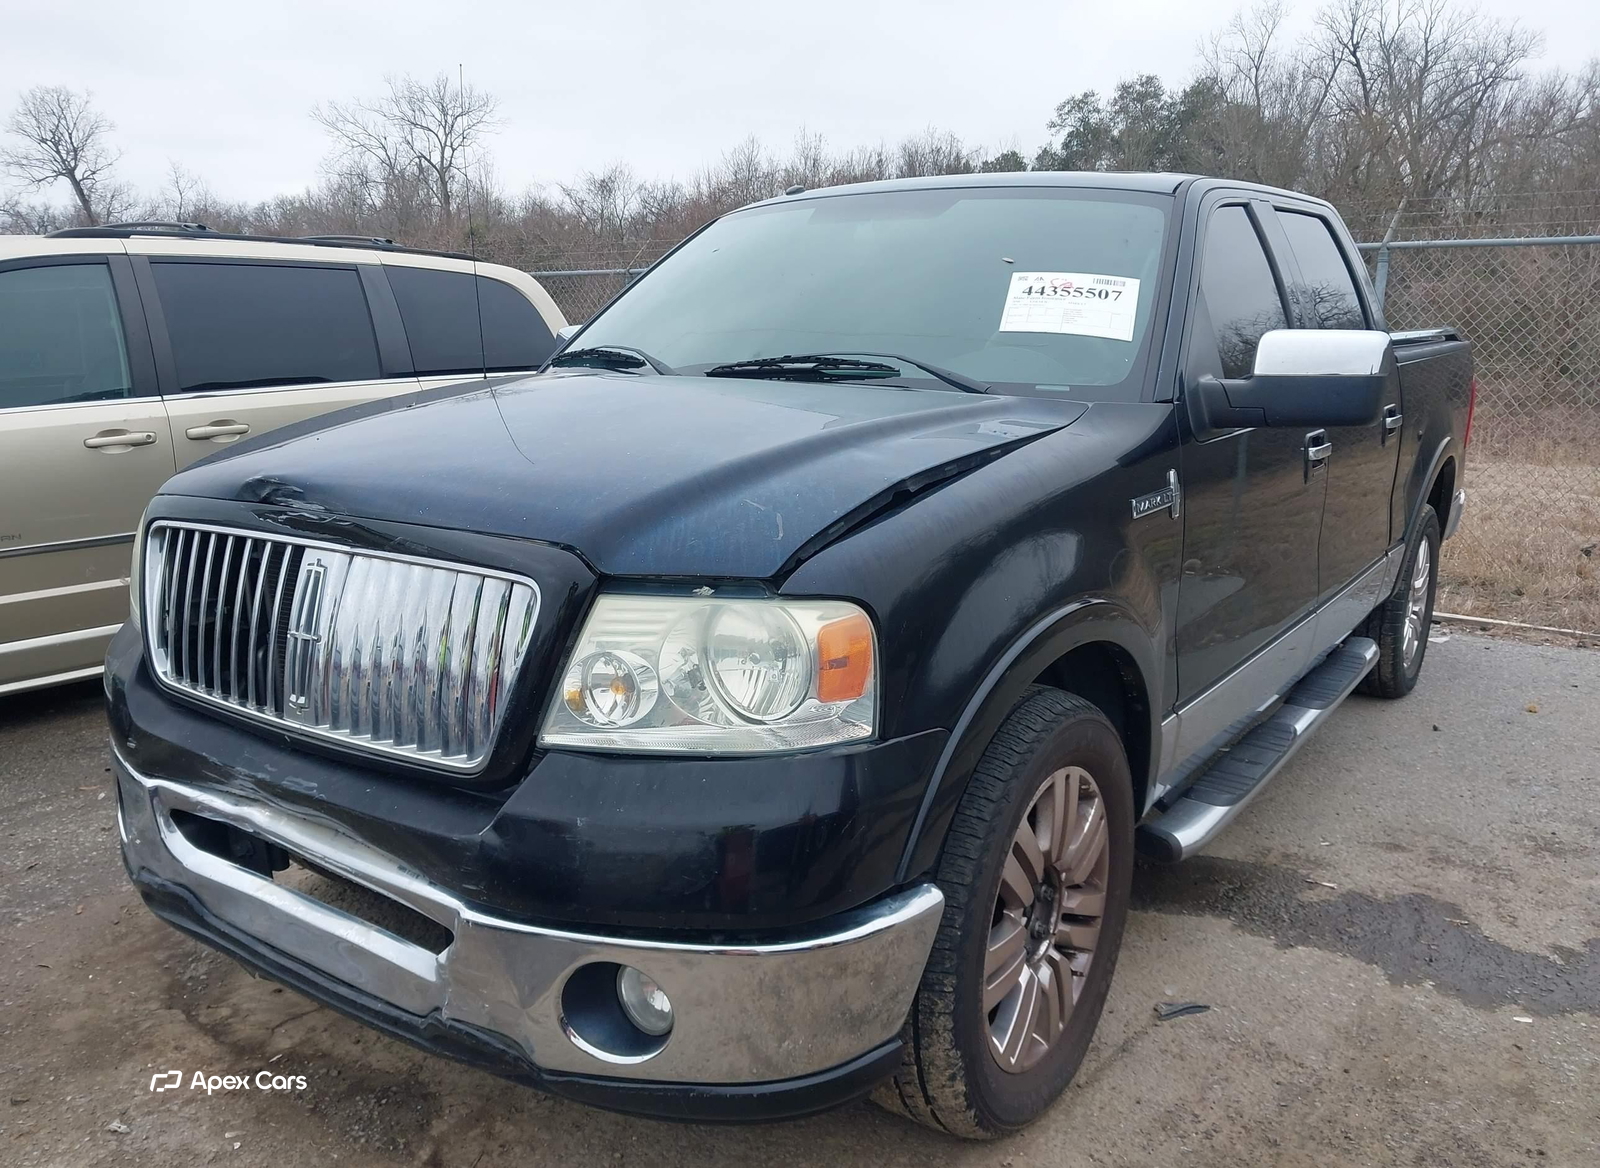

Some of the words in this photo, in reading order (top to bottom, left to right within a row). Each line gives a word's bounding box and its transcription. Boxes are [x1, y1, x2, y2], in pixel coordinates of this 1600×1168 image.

[1022, 285, 1122, 302] 44355507
[1136, 495, 1162, 513] MARK
[1163, 491, 1173, 503] LT
